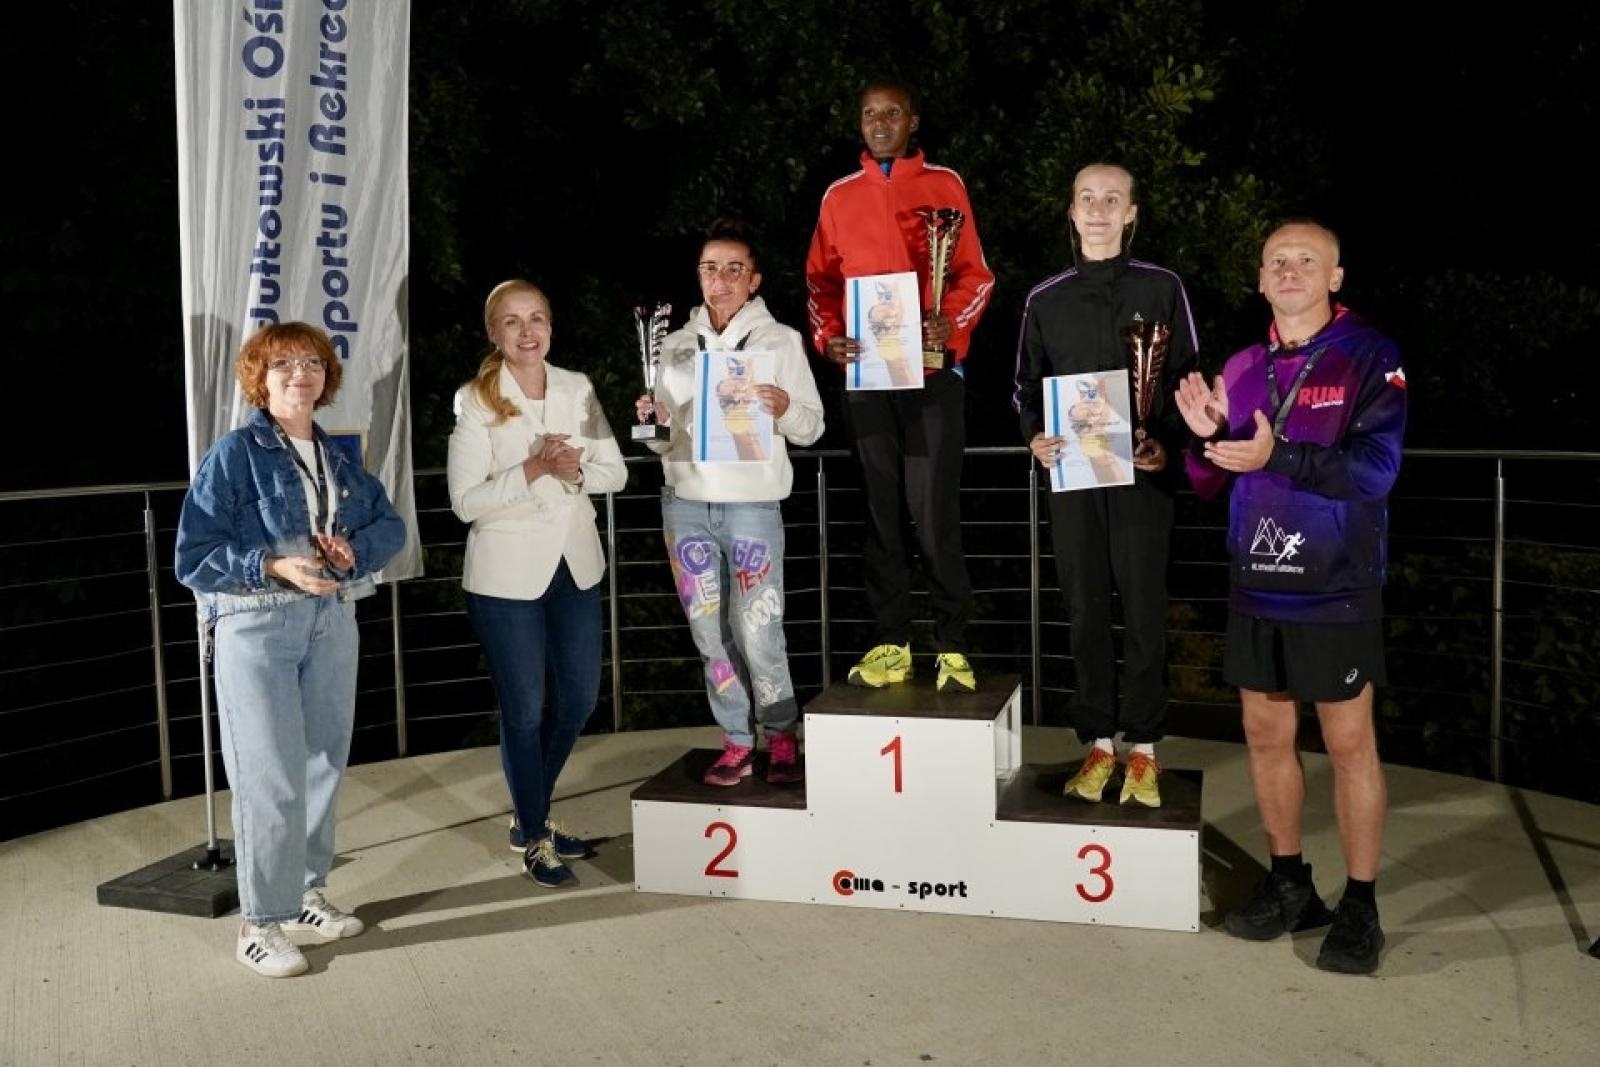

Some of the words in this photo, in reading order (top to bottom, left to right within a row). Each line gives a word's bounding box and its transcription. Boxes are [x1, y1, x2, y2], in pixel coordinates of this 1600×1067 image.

[309, 172, 346, 186] i
[243, 98, 285, 328] dułtowski
[1298, 386, 1345, 405] RUN
[880, 736, 903, 793] 1
[704, 822, 738, 878] 2
[1075, 844, 1115, 903] 3
[908, 881, 967, 899] sport
